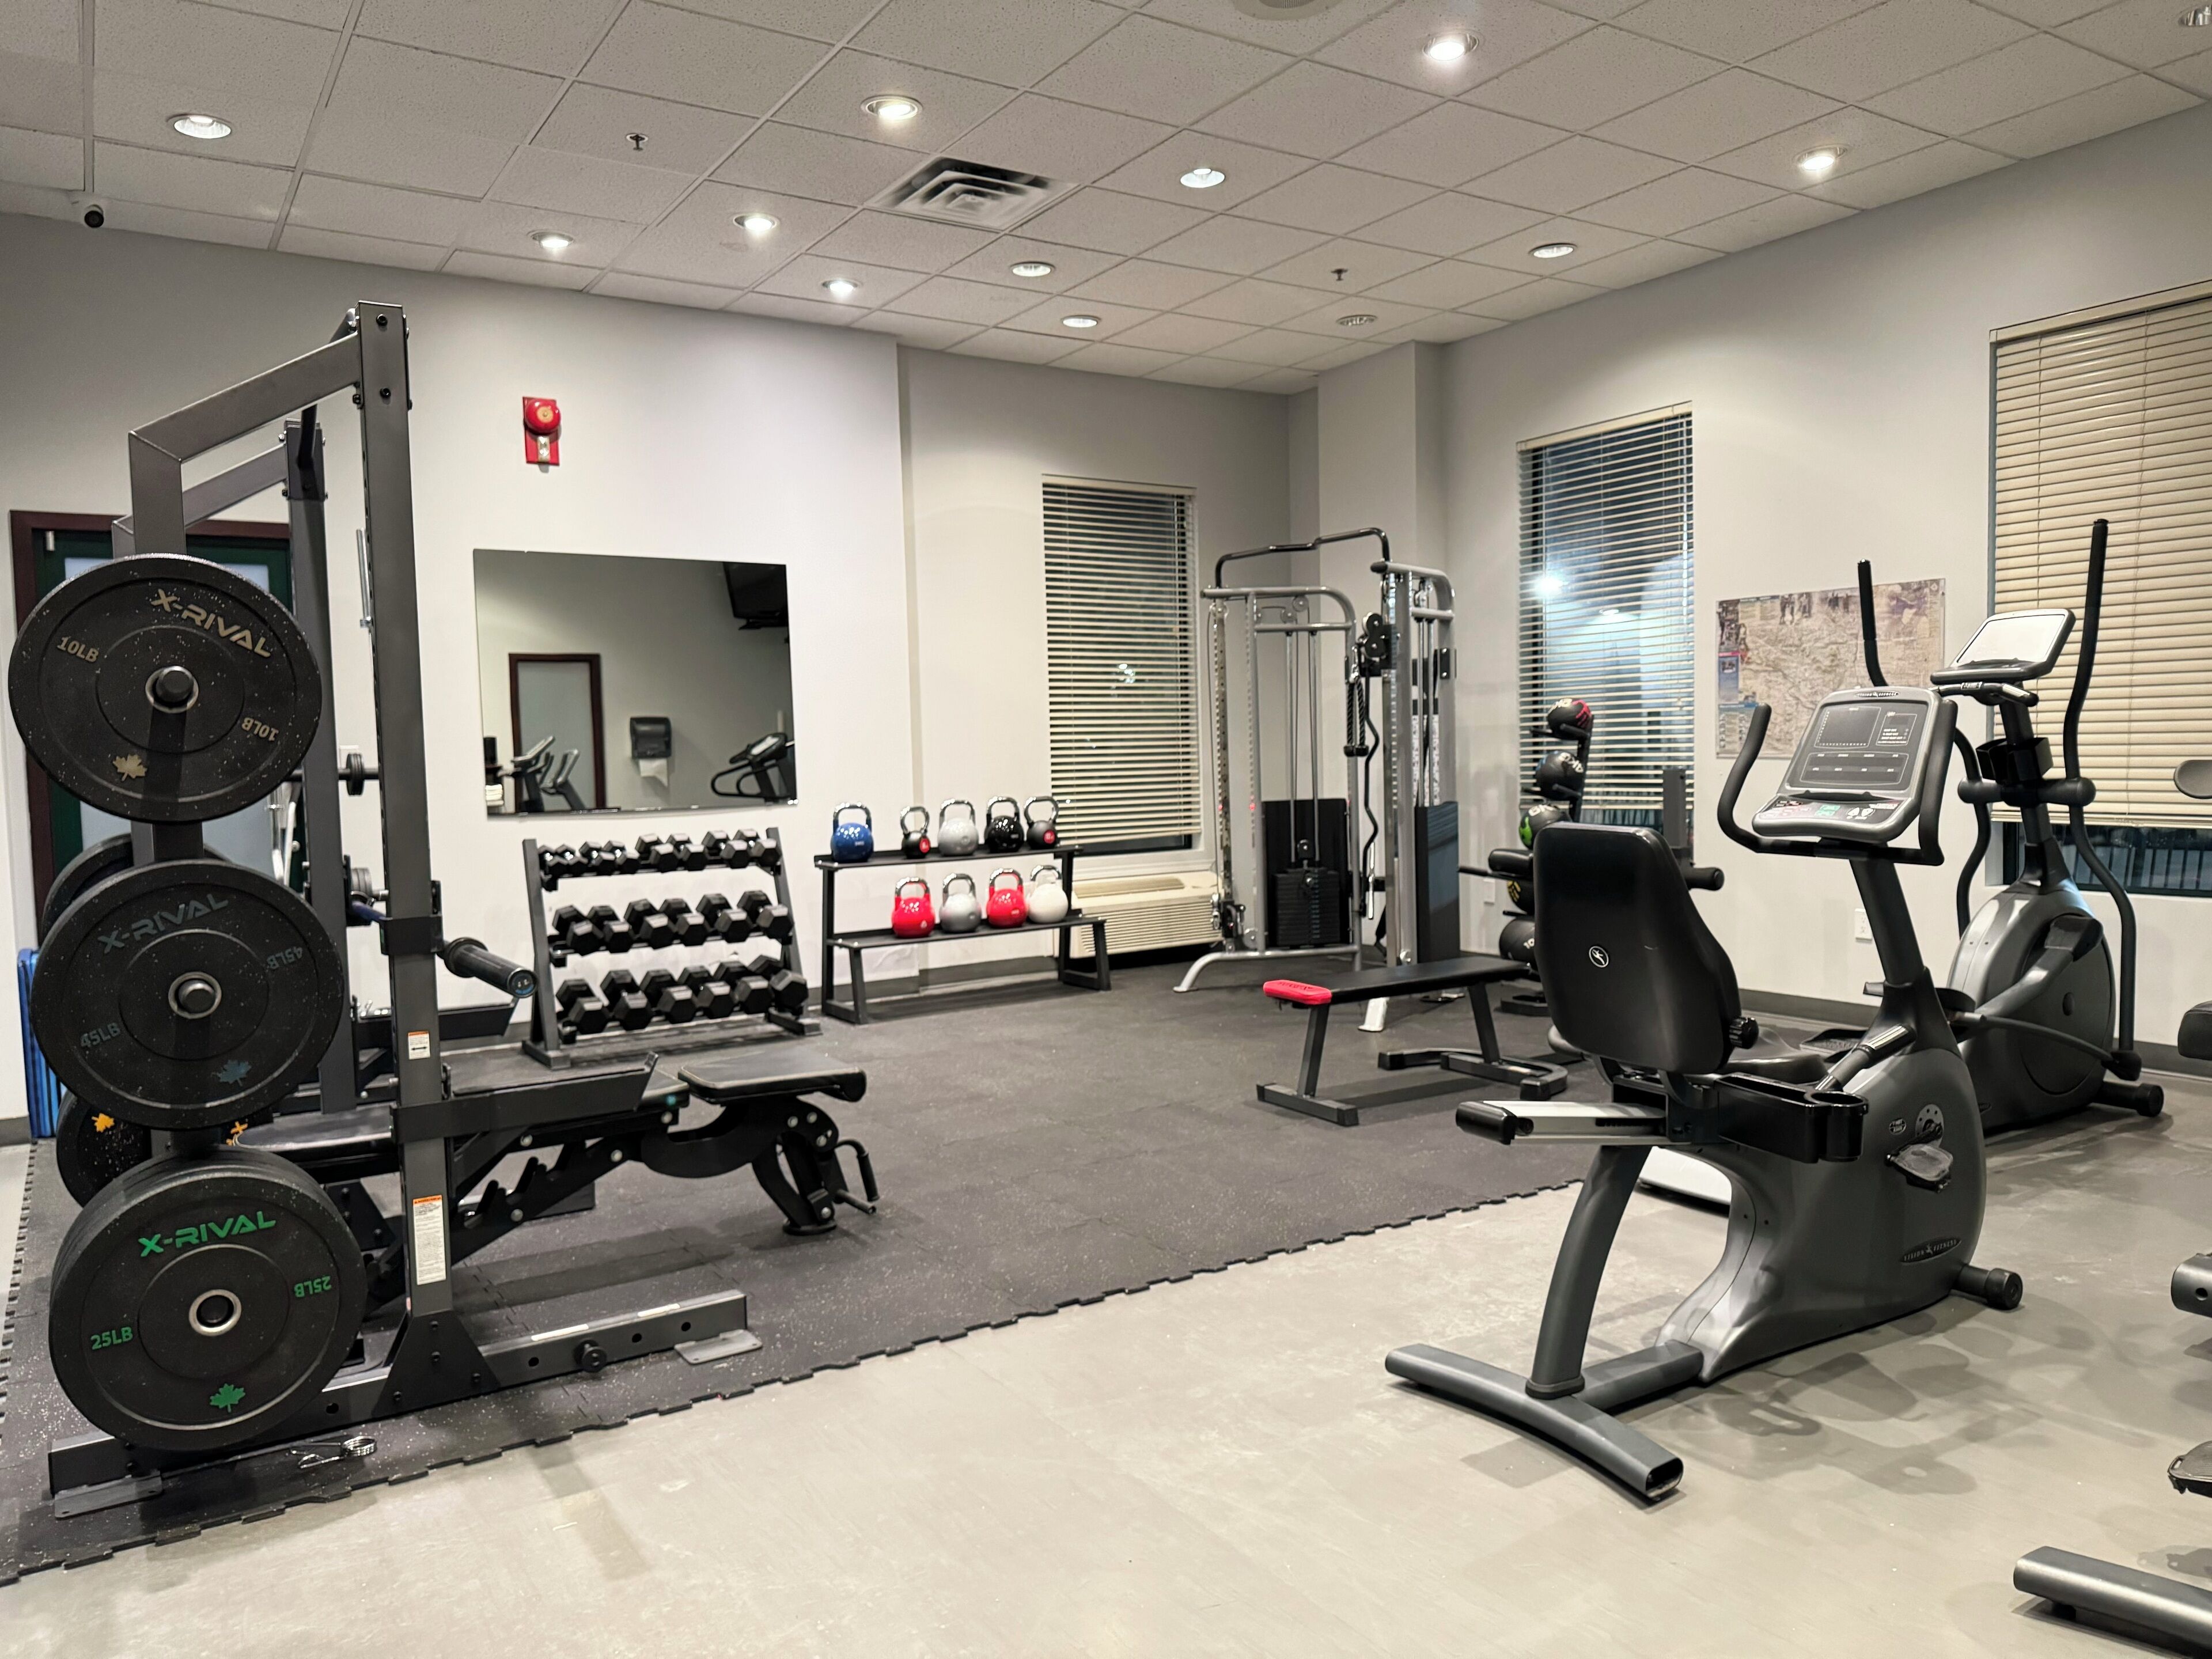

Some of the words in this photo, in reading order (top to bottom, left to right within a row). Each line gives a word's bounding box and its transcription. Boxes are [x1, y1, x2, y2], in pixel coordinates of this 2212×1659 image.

[151, 589, 271, 658] X-RIVAL
[57, 636, 99, 662] 10LB
[241, 717, 279, 741] 10LB
[97, 893, 229, 954] X-RIVAL
[267, 946, 302, 969] 45LB
[81, 1022, 120, 1047] 45LB
[138, 1211, 276, 1257] X-RIVAL
[294, 1275, 332, 1298] 25LB
[90, 1326, 134, 1350] 25LB
